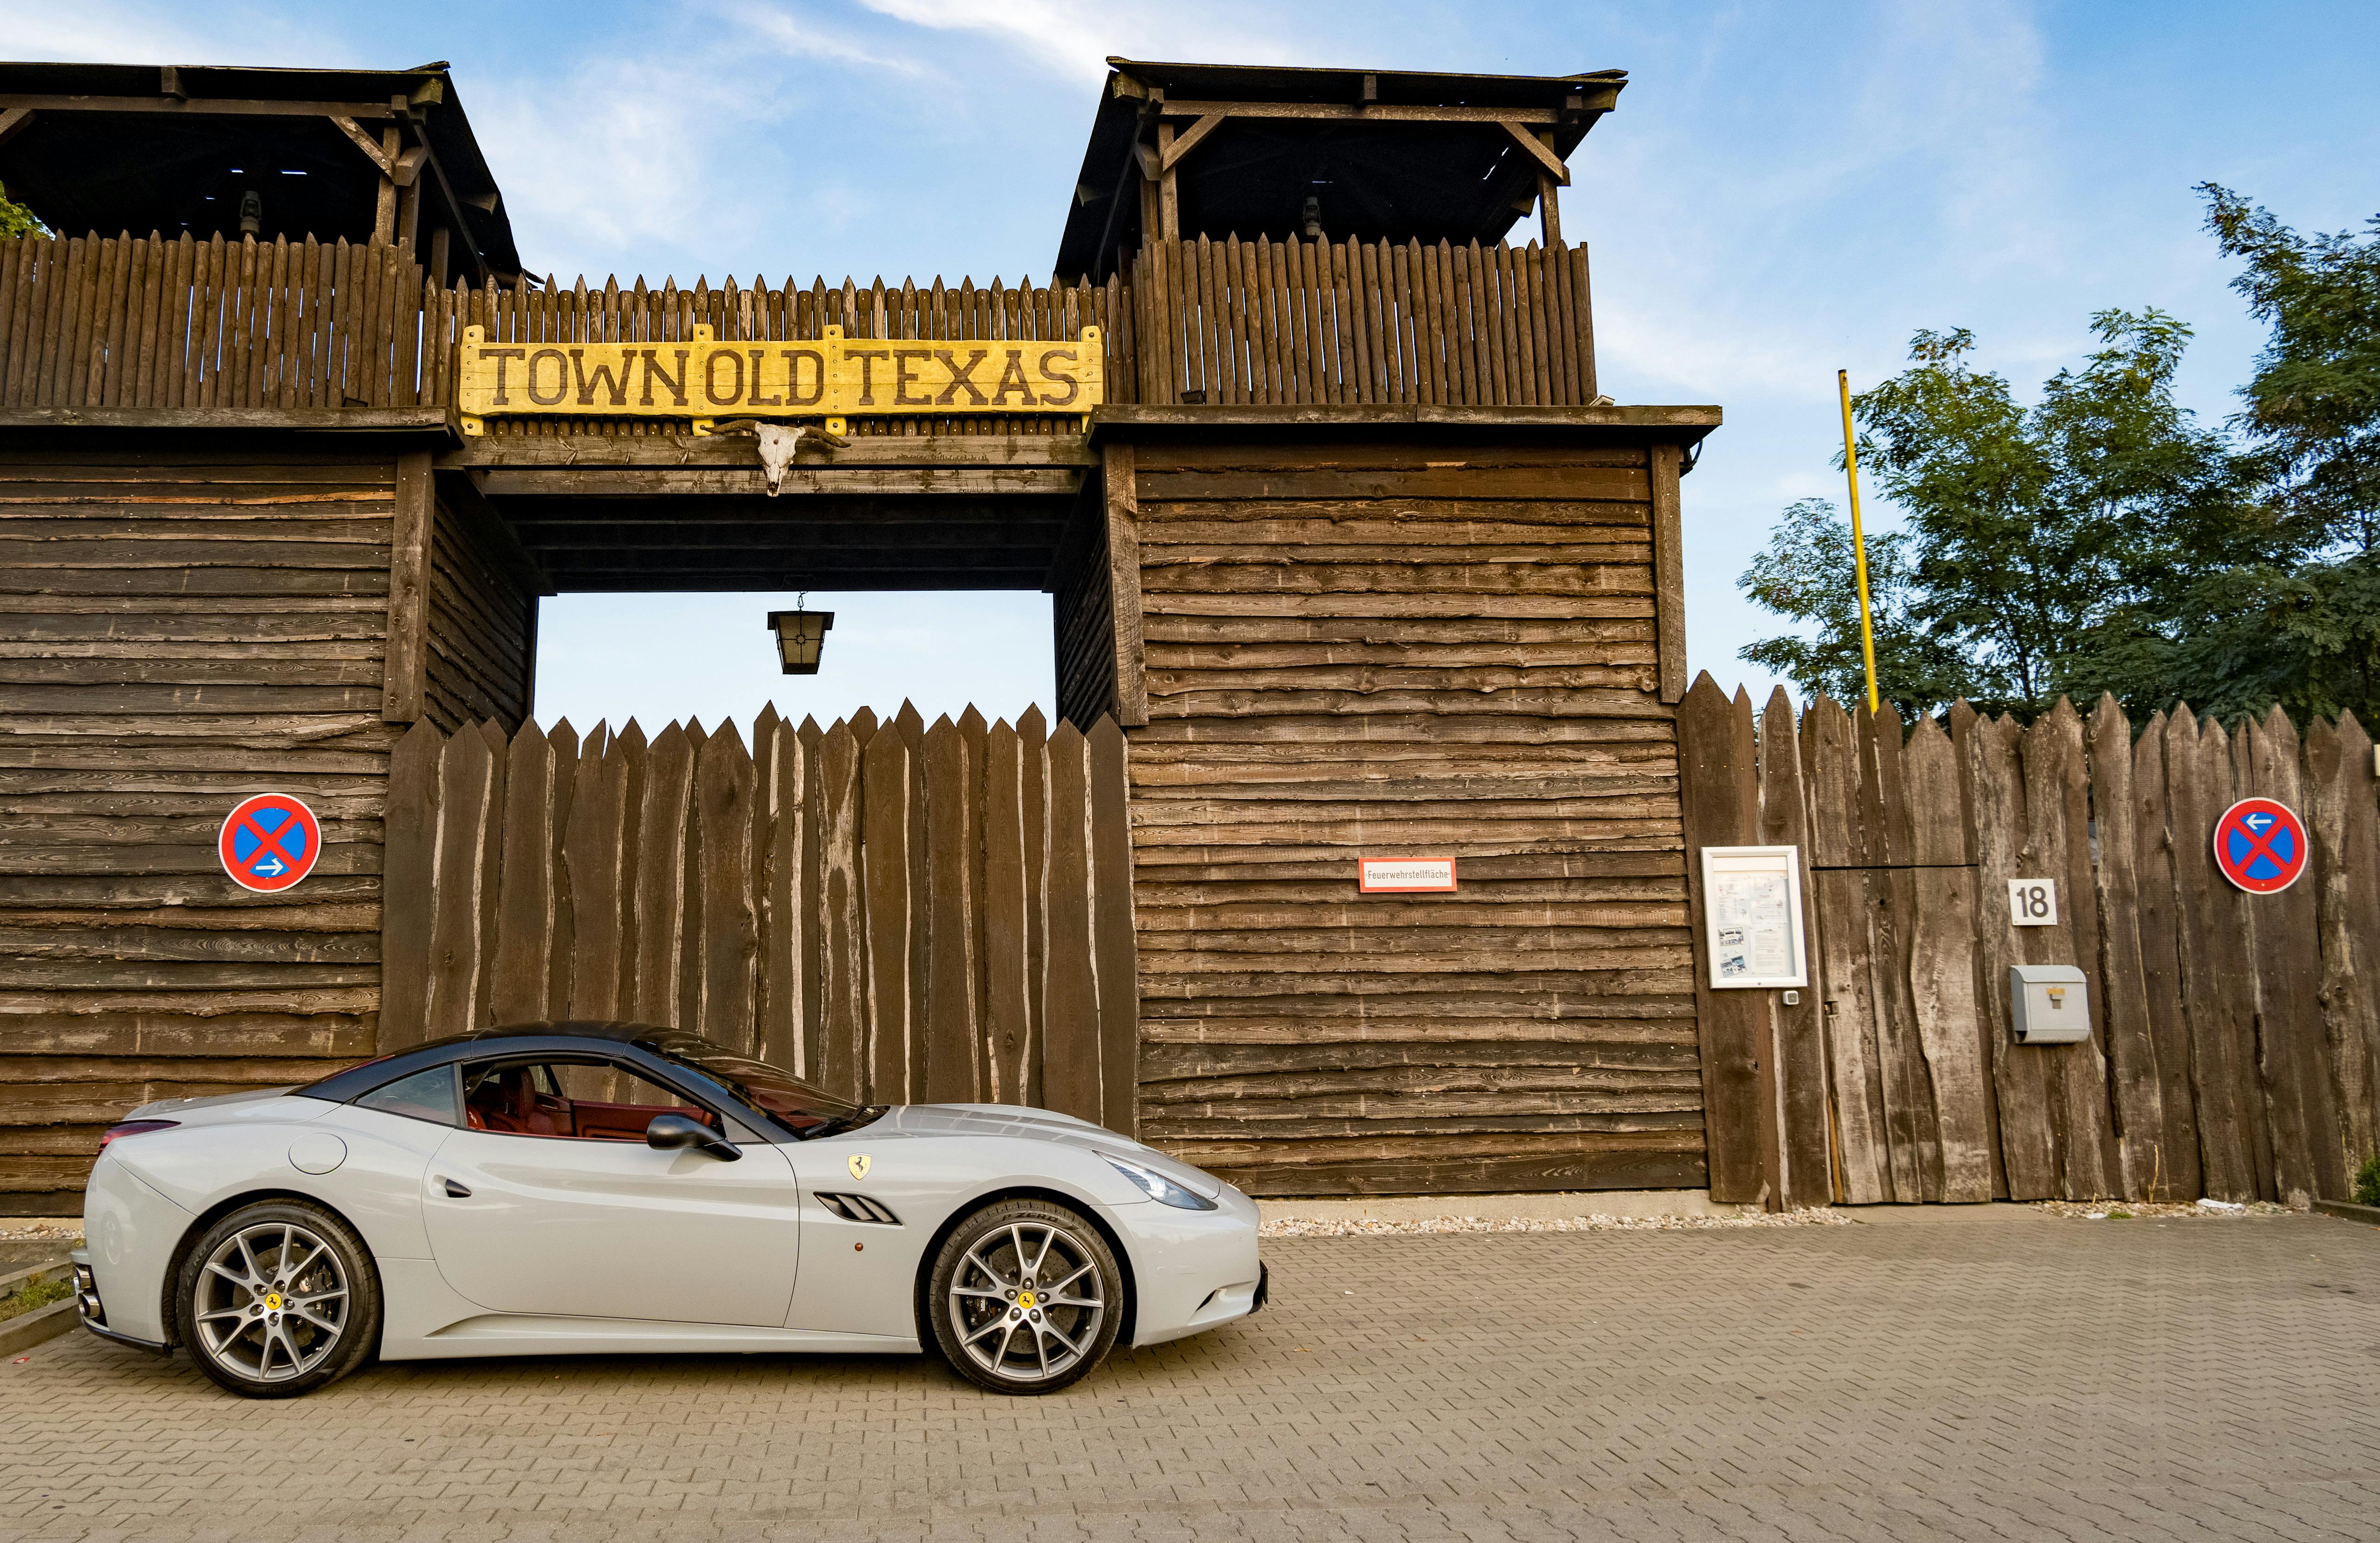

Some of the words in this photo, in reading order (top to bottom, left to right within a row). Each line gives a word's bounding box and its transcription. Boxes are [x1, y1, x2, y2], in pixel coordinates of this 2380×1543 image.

[479, 349, 689, 406] TOWN
[705, 349, 824, 406] OLD
[844, 349, 1078, 406] TEXAS
[1368, 870, 1448, 879] Feuerwehrstellfläche
[2016, 886, 2048, 918] 18
[1015, 1212, 1059, 1222] ZERO
